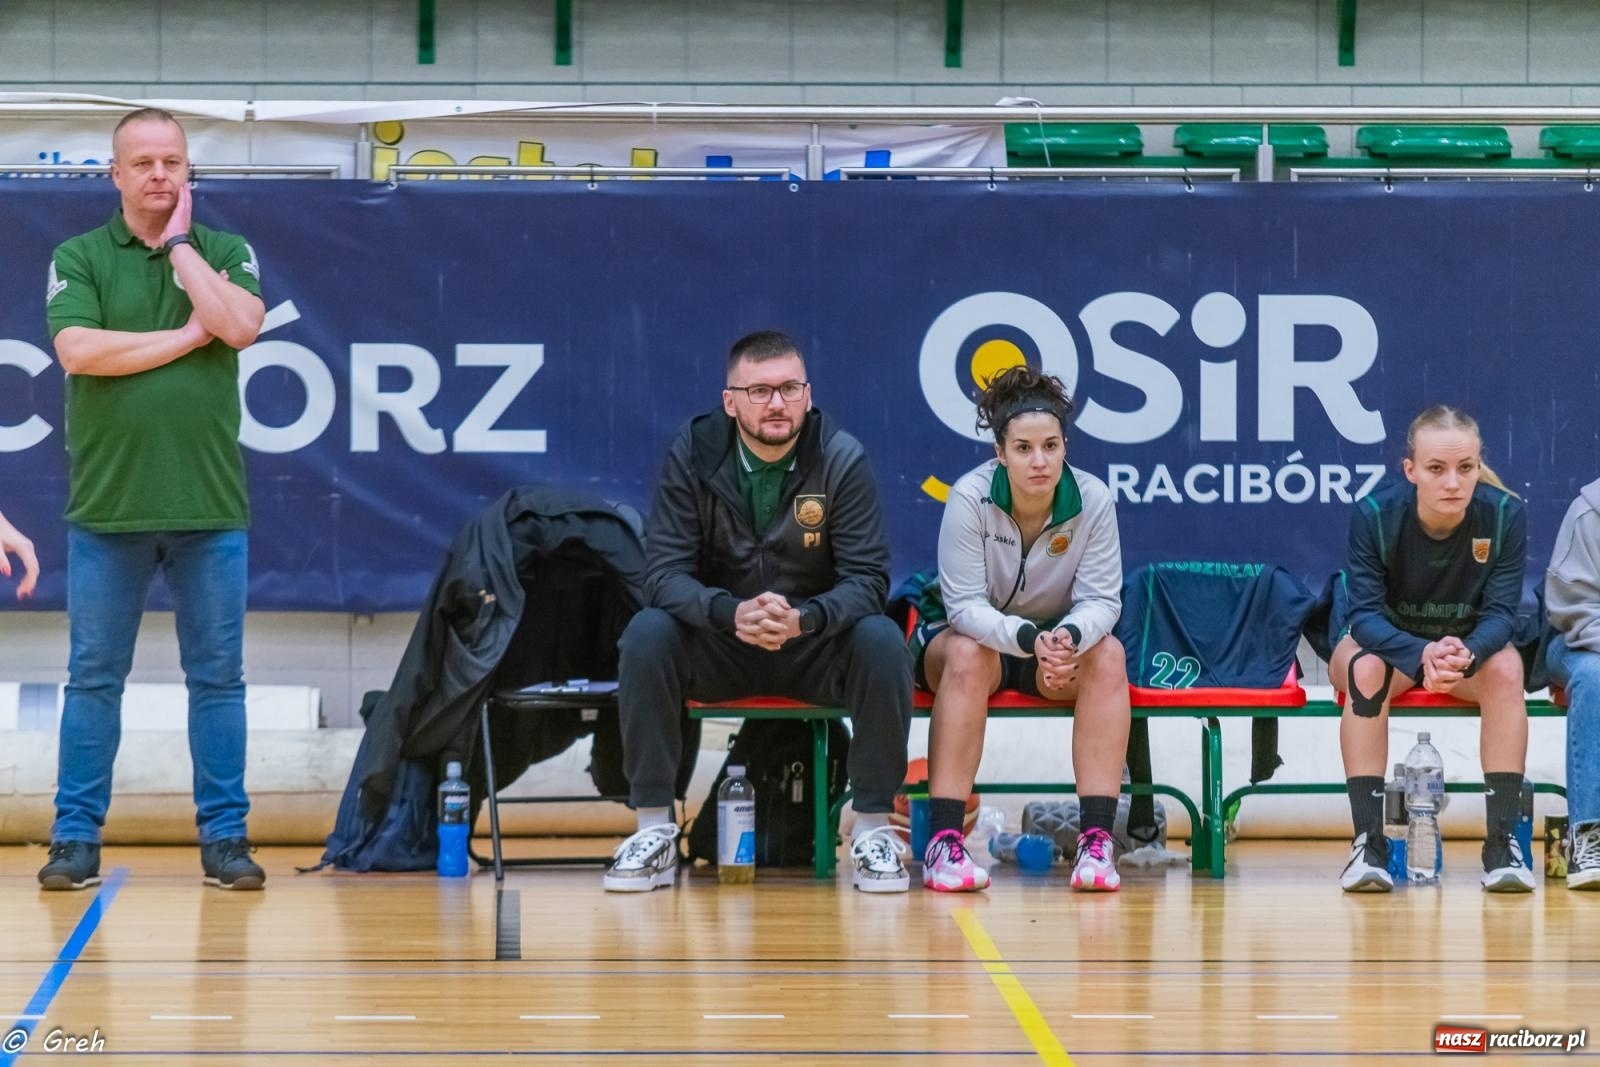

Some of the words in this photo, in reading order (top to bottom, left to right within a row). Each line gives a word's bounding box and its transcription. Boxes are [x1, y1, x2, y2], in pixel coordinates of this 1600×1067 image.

[0, 299, 548, 454] CÓRZ
[918, 291, 1386, 444] OSiR
[1107, 449, 1386, 504] RACIBÓRZ
[1150, 651, 1201, 690] 22
